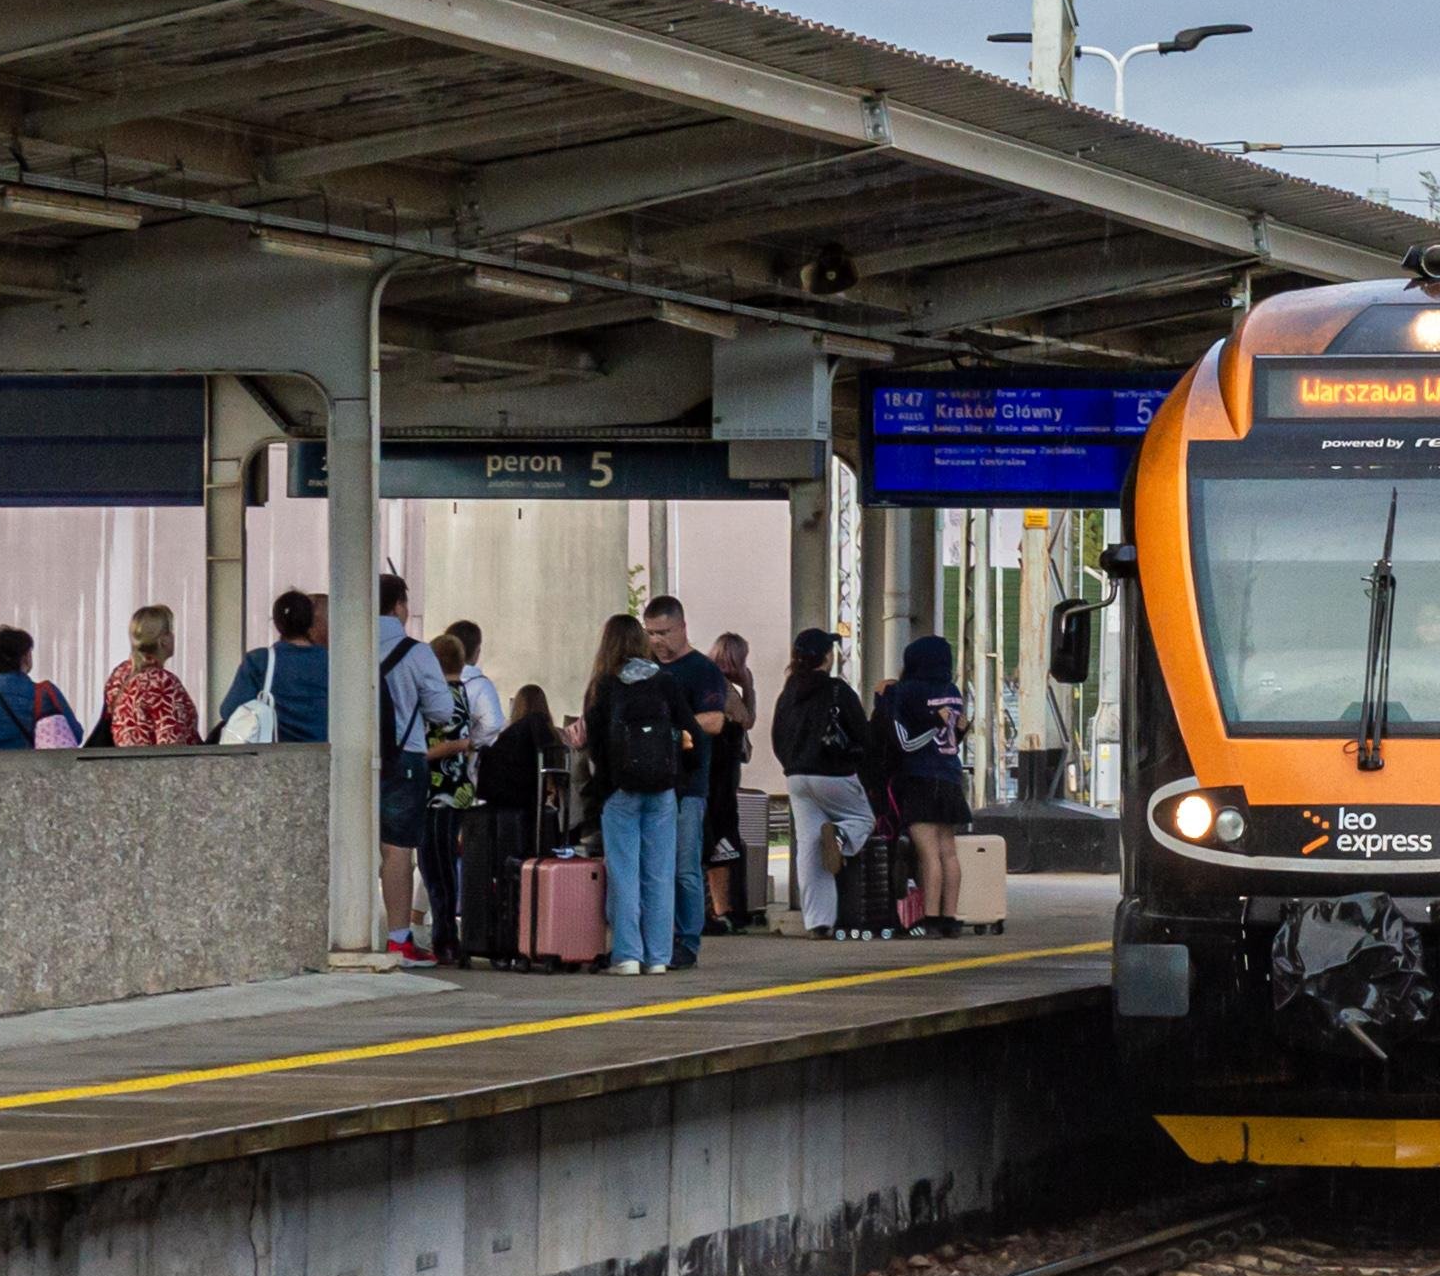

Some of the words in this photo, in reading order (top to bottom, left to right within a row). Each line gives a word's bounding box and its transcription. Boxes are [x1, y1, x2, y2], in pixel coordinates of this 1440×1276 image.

[1301, 377, 1417, 403] Warszawa
[883, 392, 923, 408] 18:47
[934, 403, 998, 419] Kraków
[1001, 405, 1063, 422] Główny
[1136, 398, 1153, 424] 5
[1321, 437, 1385, 450] powered
[1386, 438, 1404, 450] by
[486, 454, 561, 477] peron
[588, 450, 613, 489] 5
[1337, 806, 1377, 830] leo
[1336, 833, 1433, 858] express
